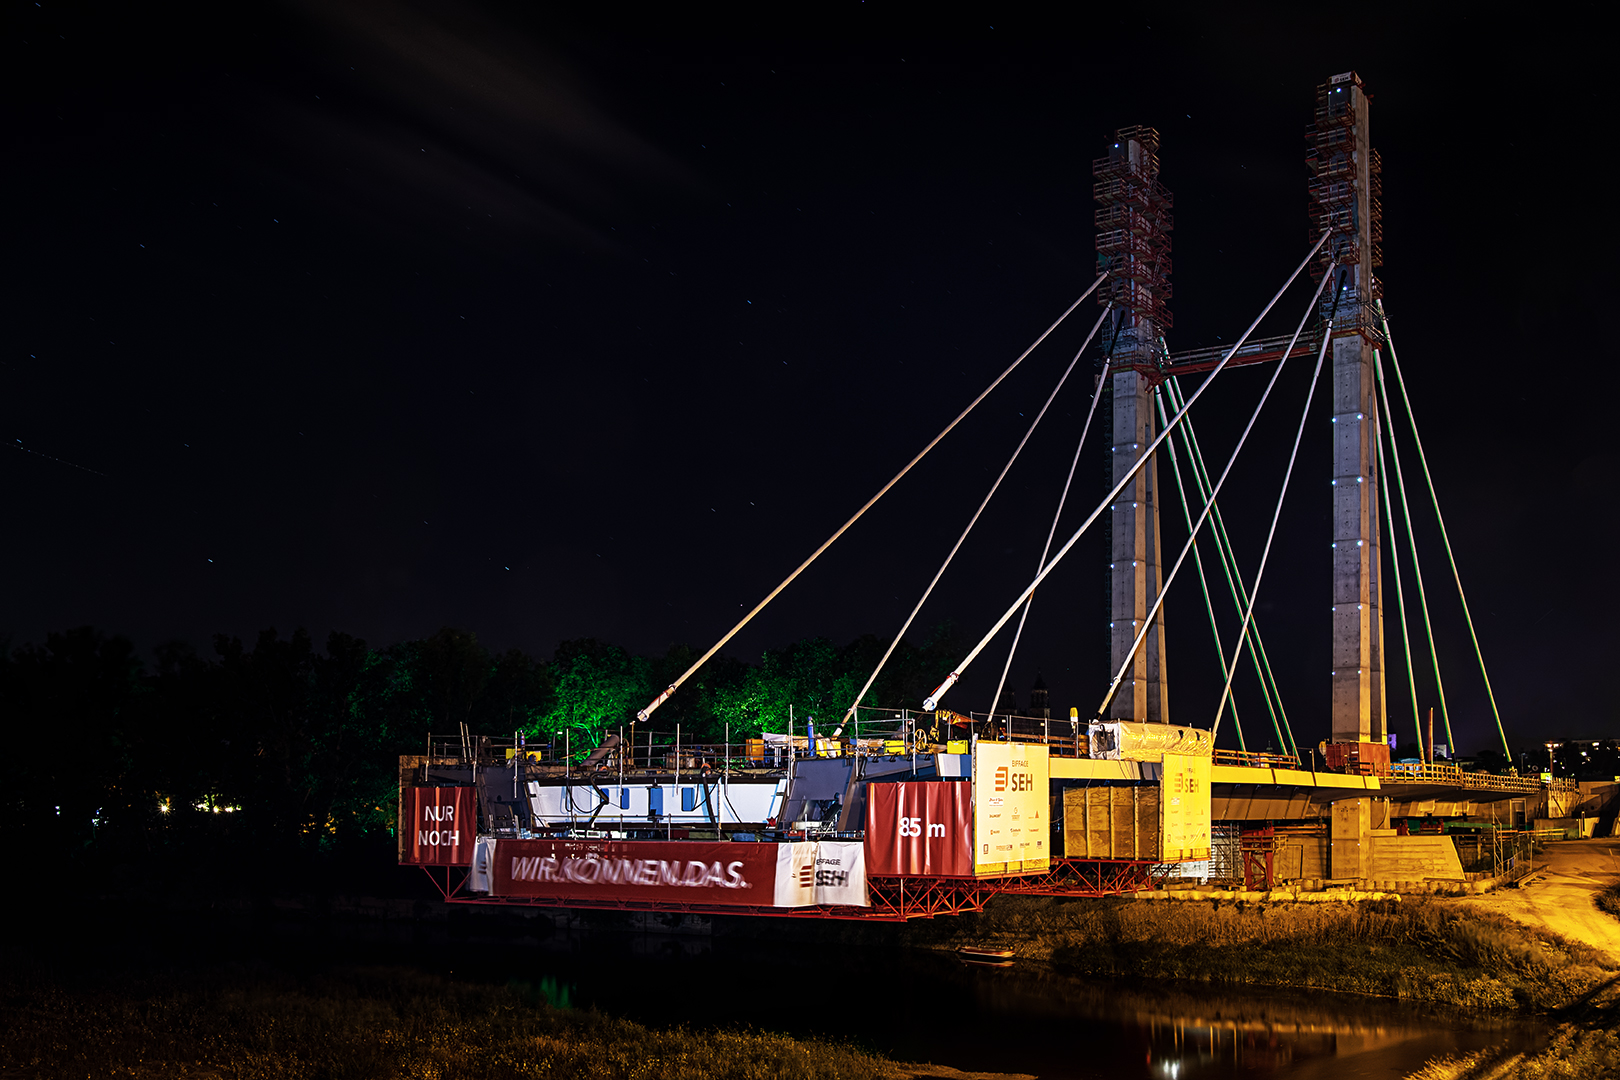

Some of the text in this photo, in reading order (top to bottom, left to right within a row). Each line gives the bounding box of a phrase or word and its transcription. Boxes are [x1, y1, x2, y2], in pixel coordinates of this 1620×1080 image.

[1011, 772, 1033, 792] SEH
[1184, 778, 1199, 793] SEH
[424, 805, 454, 822] NUR
[898, 816, 946, 838] 85 m
[418, 829, 460, 846] NOCH
